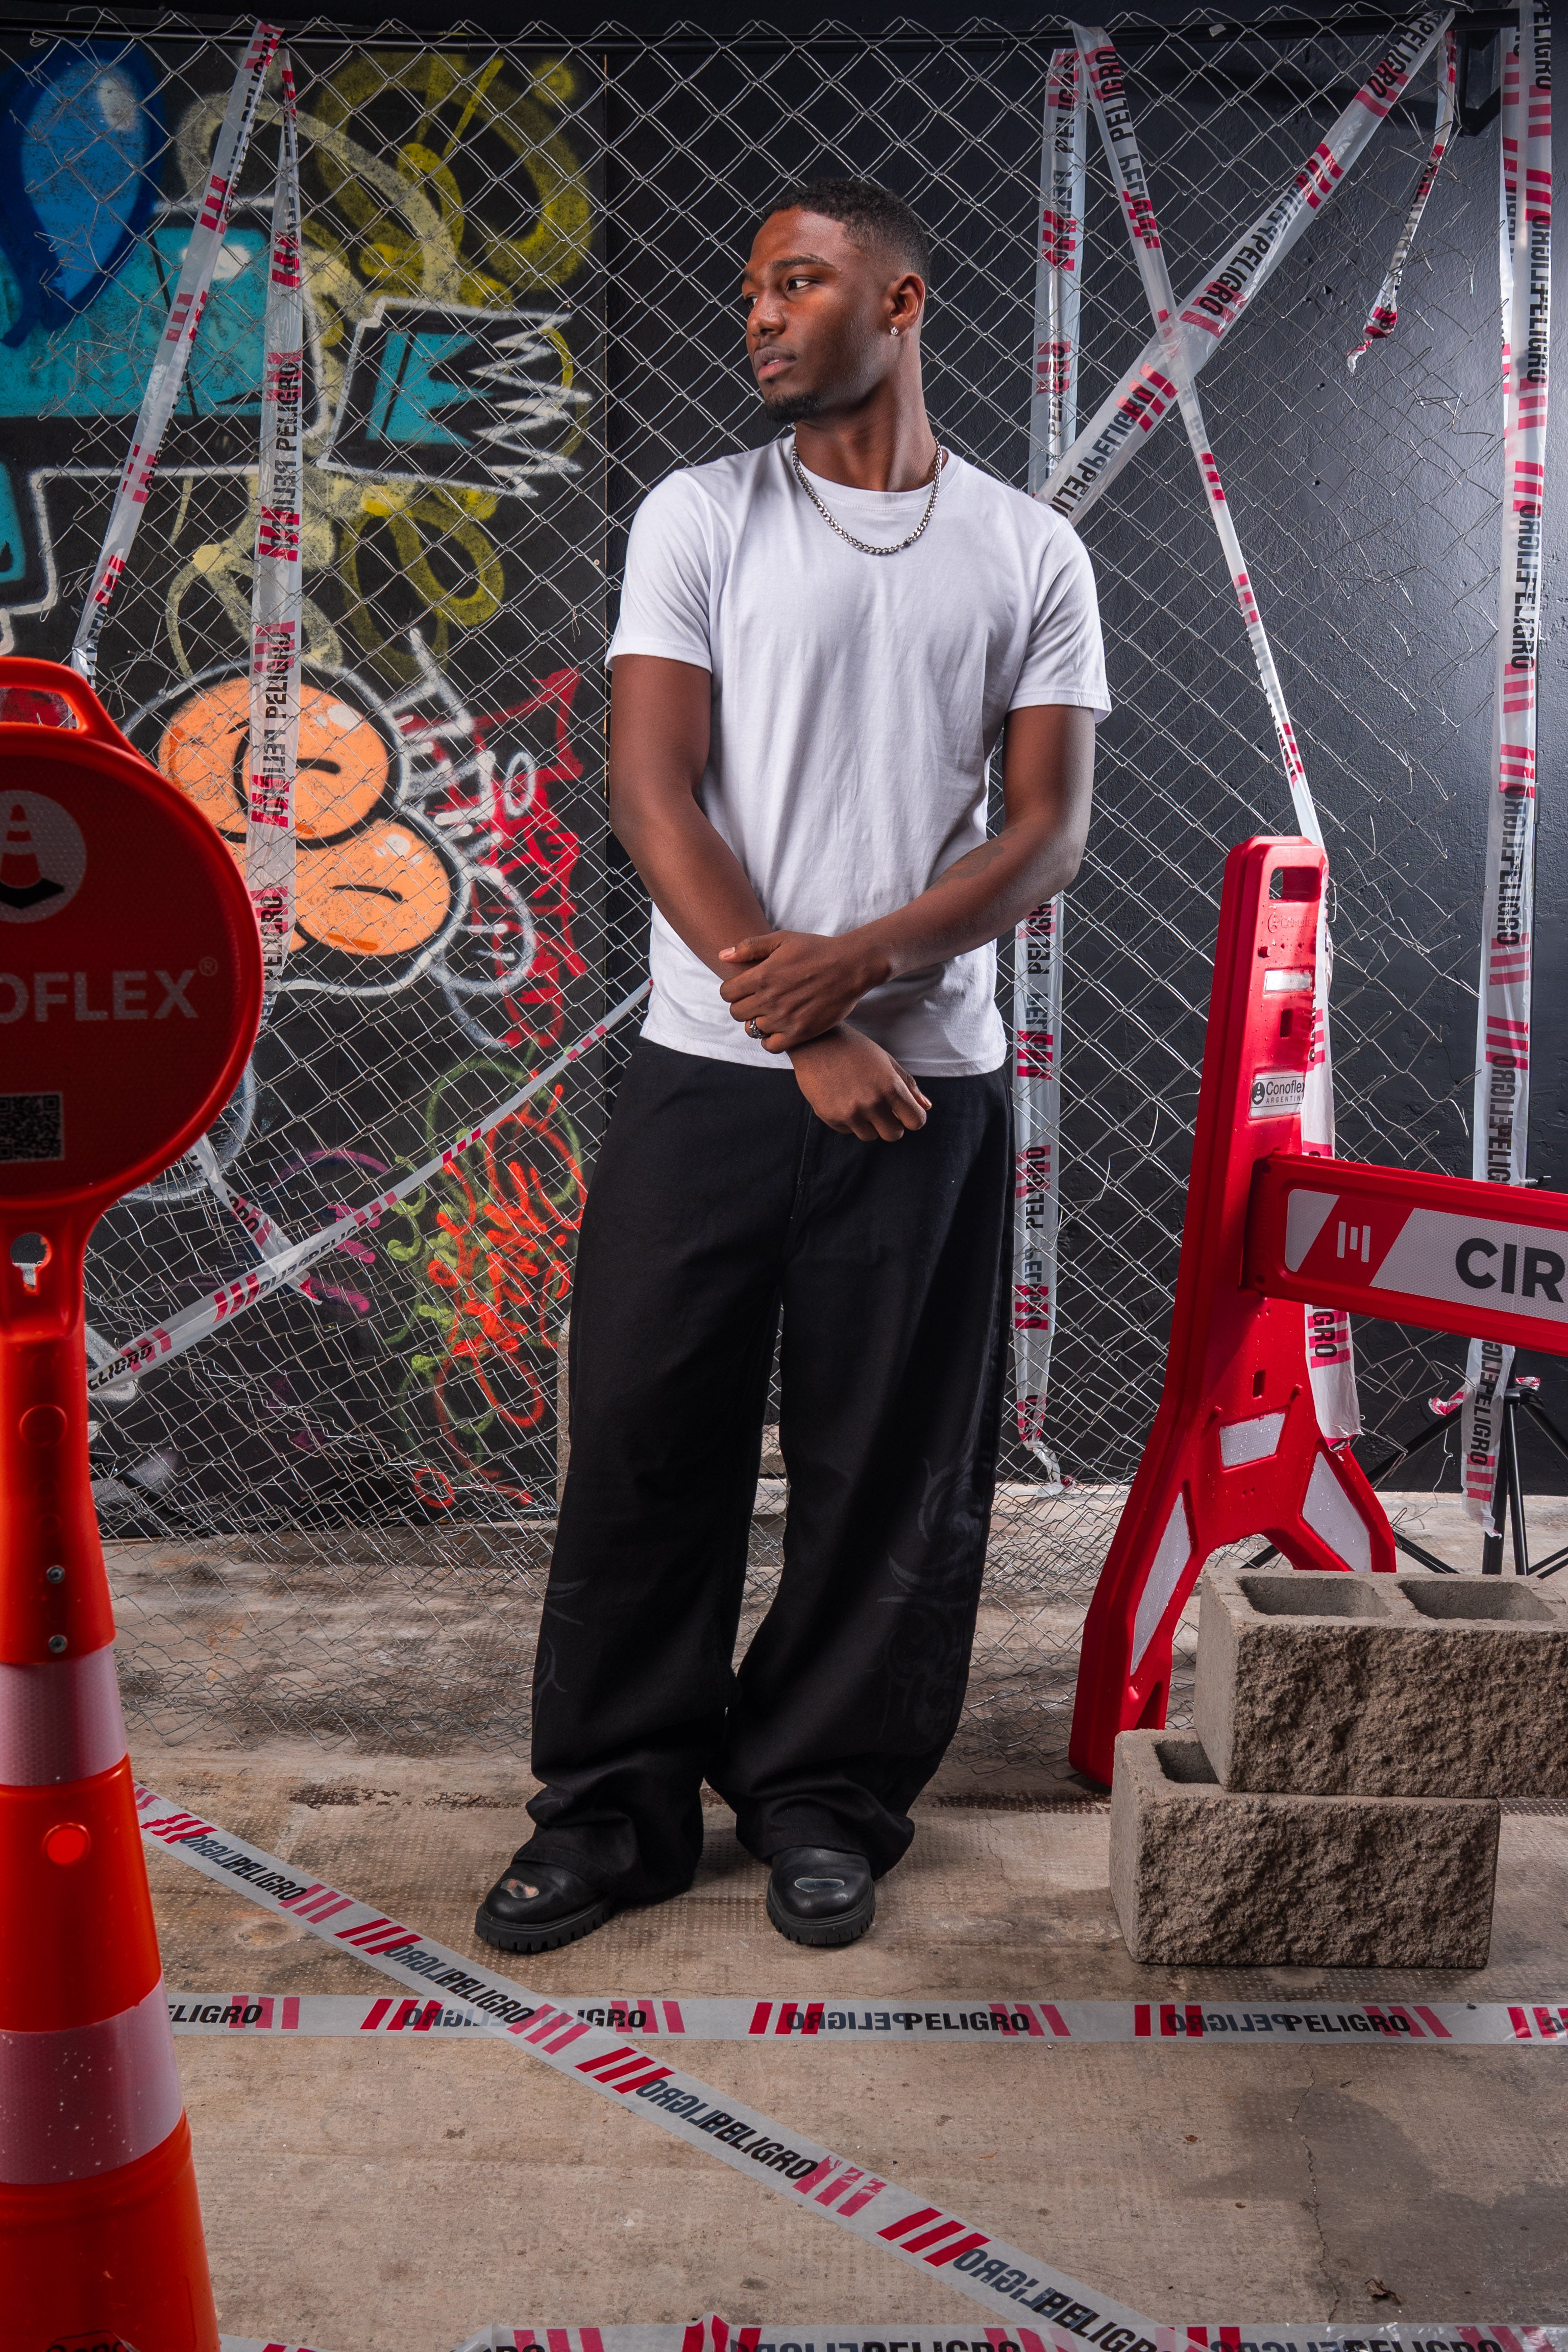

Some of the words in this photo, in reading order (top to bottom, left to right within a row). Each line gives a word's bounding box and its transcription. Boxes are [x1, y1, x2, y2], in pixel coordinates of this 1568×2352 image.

[1366, 19, 1435, 98] PELIGRO
[1095, 50, 1134, 142] PELIGRO
[1199, 234, 1270, 316] PELIGRO
[276, 362, 299, 451] PELIGRO
[1048, 462, 1099, 519] PELI
[265, 632, 291, 719] PELIGRO
[1027, 898, 1051, 974] PELIGR
[1266, 1094, 1304, 1104] ARGENTIN
[1487, 1123, 1512, 1185] PELIG
[1026, 1146, 1046, 1230] PELIGRO
[1456, 1237, 1565, 1303] CIR
[87, 1344, 152, 1391] ELIGRO
[221, 1856, 307, 1900] PELIGRO
[434, 1971, 535, 2024] PELIGRO
[904, 2012, 1030, 2031] PELIGRO
[1283, 2014, 1411, 2032] PELIGRO
[698, 2112, 819, 2179] PELIGRO
[1032, 2292, 1170, 2352] PELIGR
